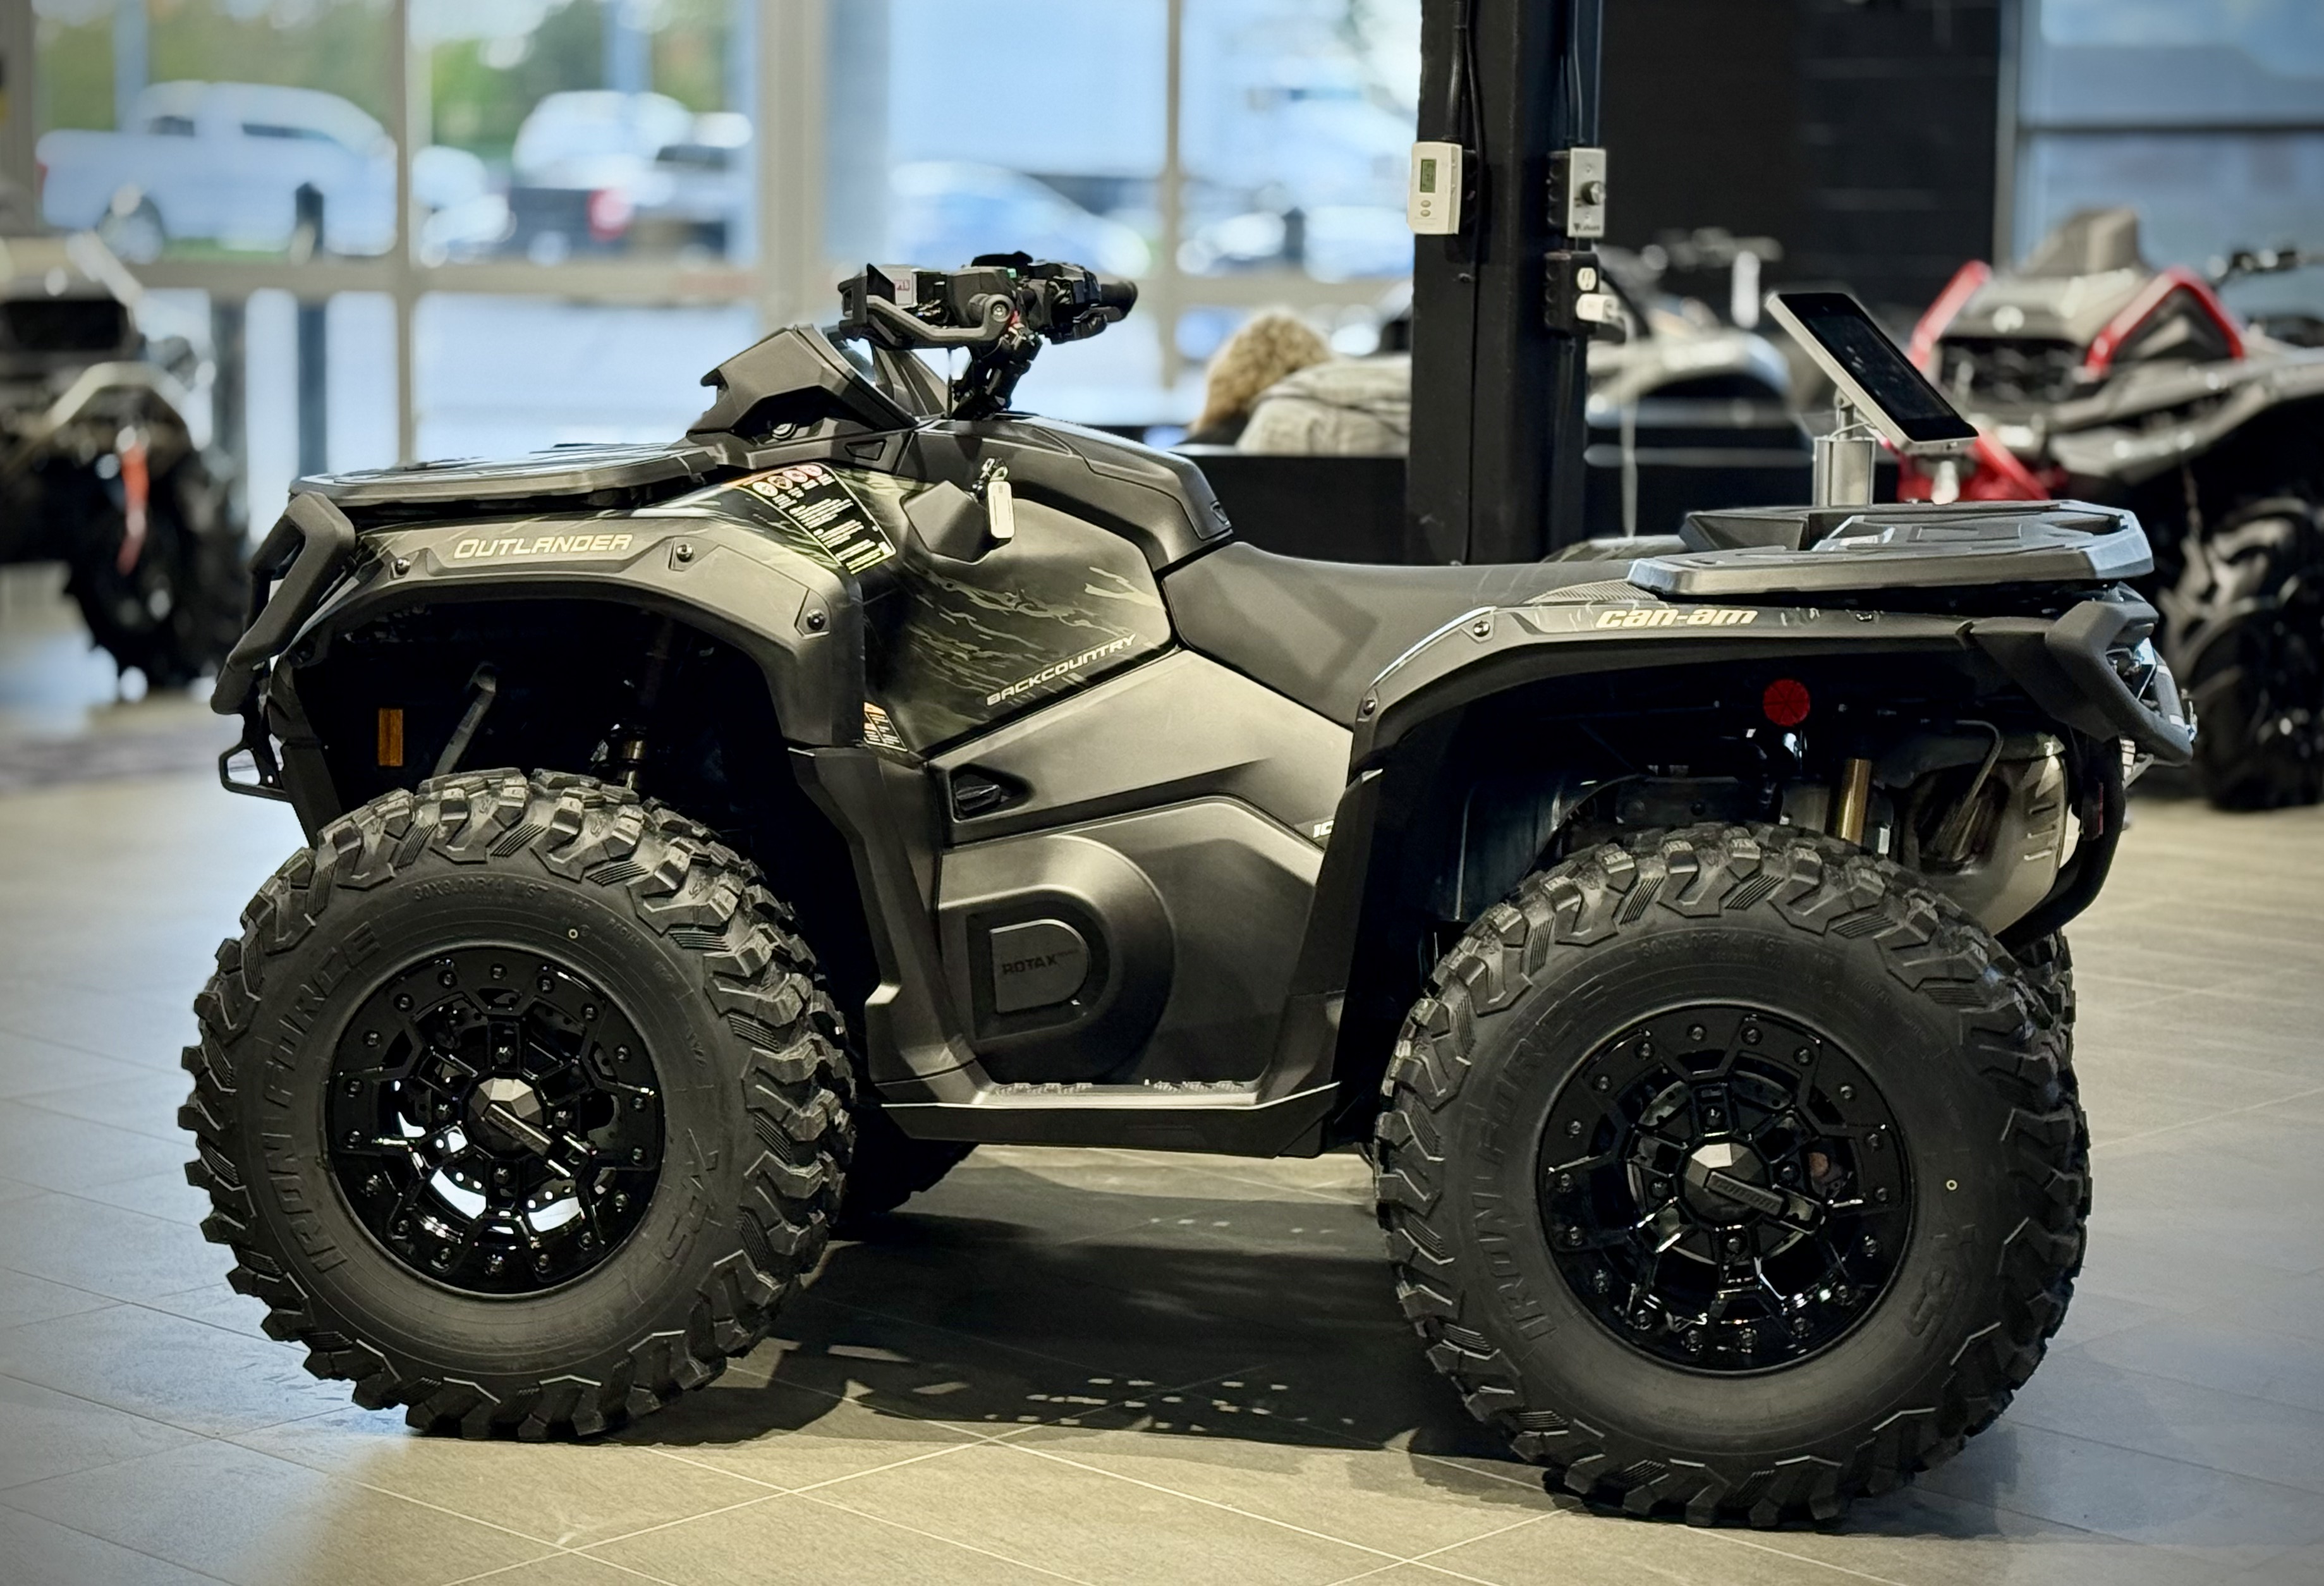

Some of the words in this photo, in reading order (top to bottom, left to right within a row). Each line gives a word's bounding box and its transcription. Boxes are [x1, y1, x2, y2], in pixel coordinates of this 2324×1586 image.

[454, 534, 633, 559] OUTLANDER
[1595, 609, 1758, 628] can-am
[987, 633, 1136, 706] BACKCOUNTRY
[1002, 954, 1057, 975] ROTAX
[265, 920, 382, 1109] FORCE
